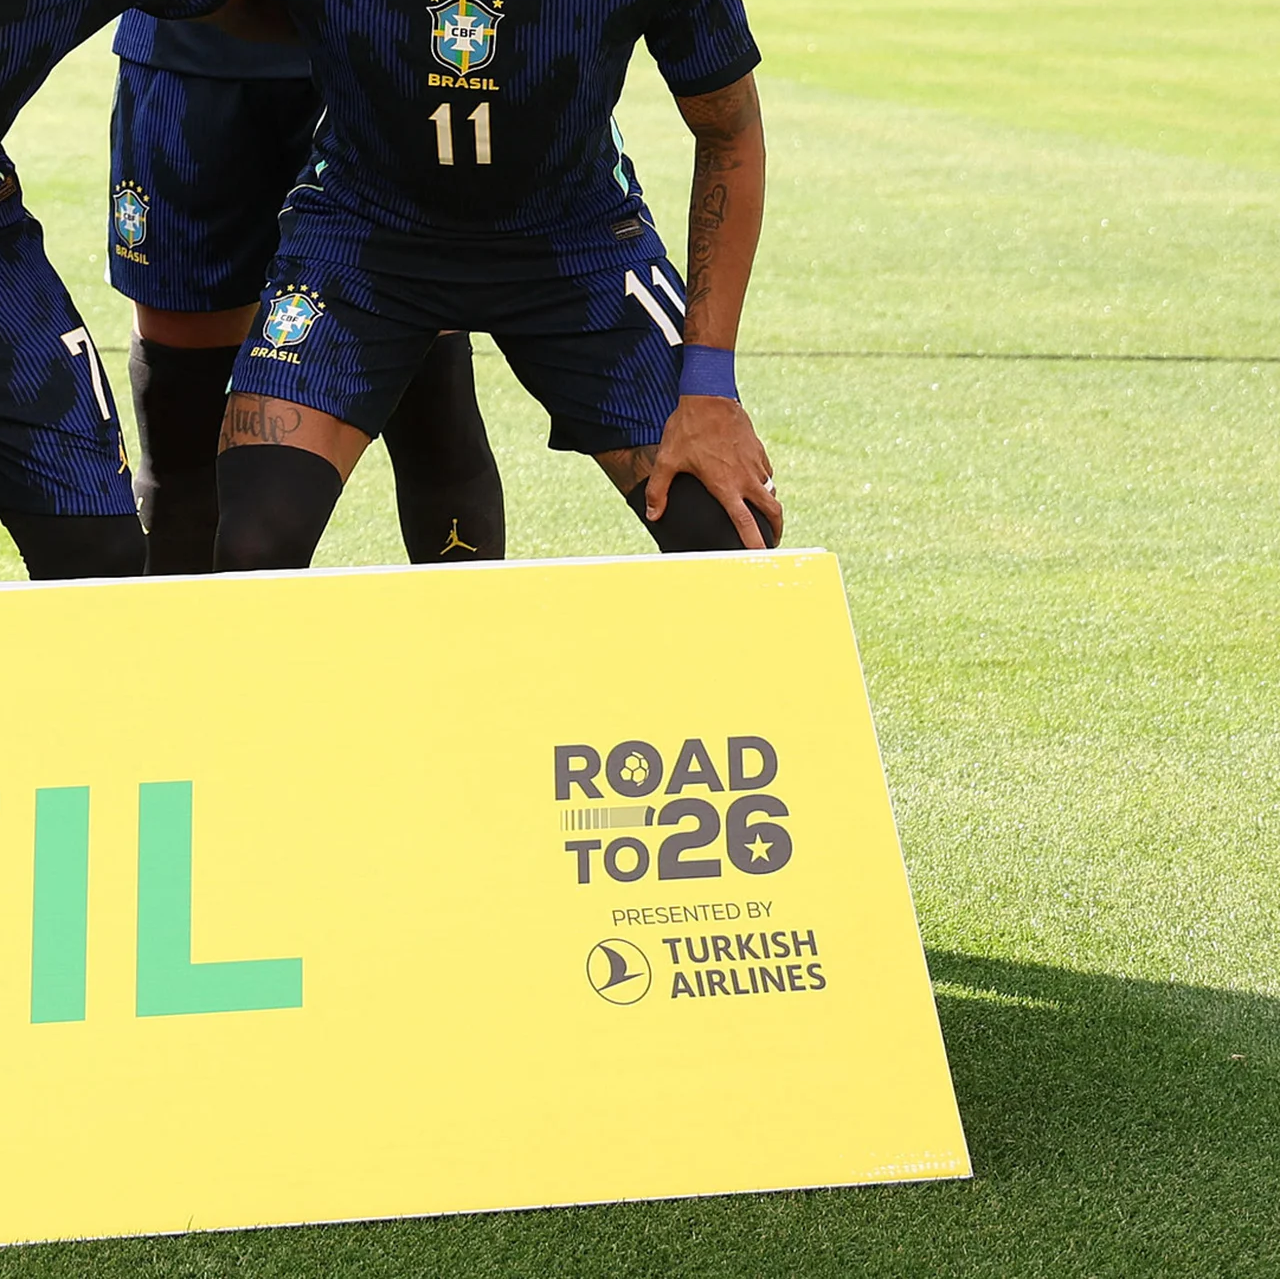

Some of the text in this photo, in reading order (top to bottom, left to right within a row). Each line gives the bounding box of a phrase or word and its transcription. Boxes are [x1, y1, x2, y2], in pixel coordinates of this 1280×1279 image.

[450, 26, 477, 39] CBF
[427, 72, 500, 92] BRASIL
[429, 102, 492, 165] 11
[115, 244, 150, 266] BRASIL
[625, 265, 686, 346] 11
[250, 346, 301, 365] BRASIL
[61, 326, 111, 421] 7
[554, 735, 778, 801] ROAD
[564, 836, 650, 884] TO
[612, 901, 773, 926] PRESENTED BY
[662, 929, 818, 964] TURKISH
[671, 963, 827, 999] AIRLINES
